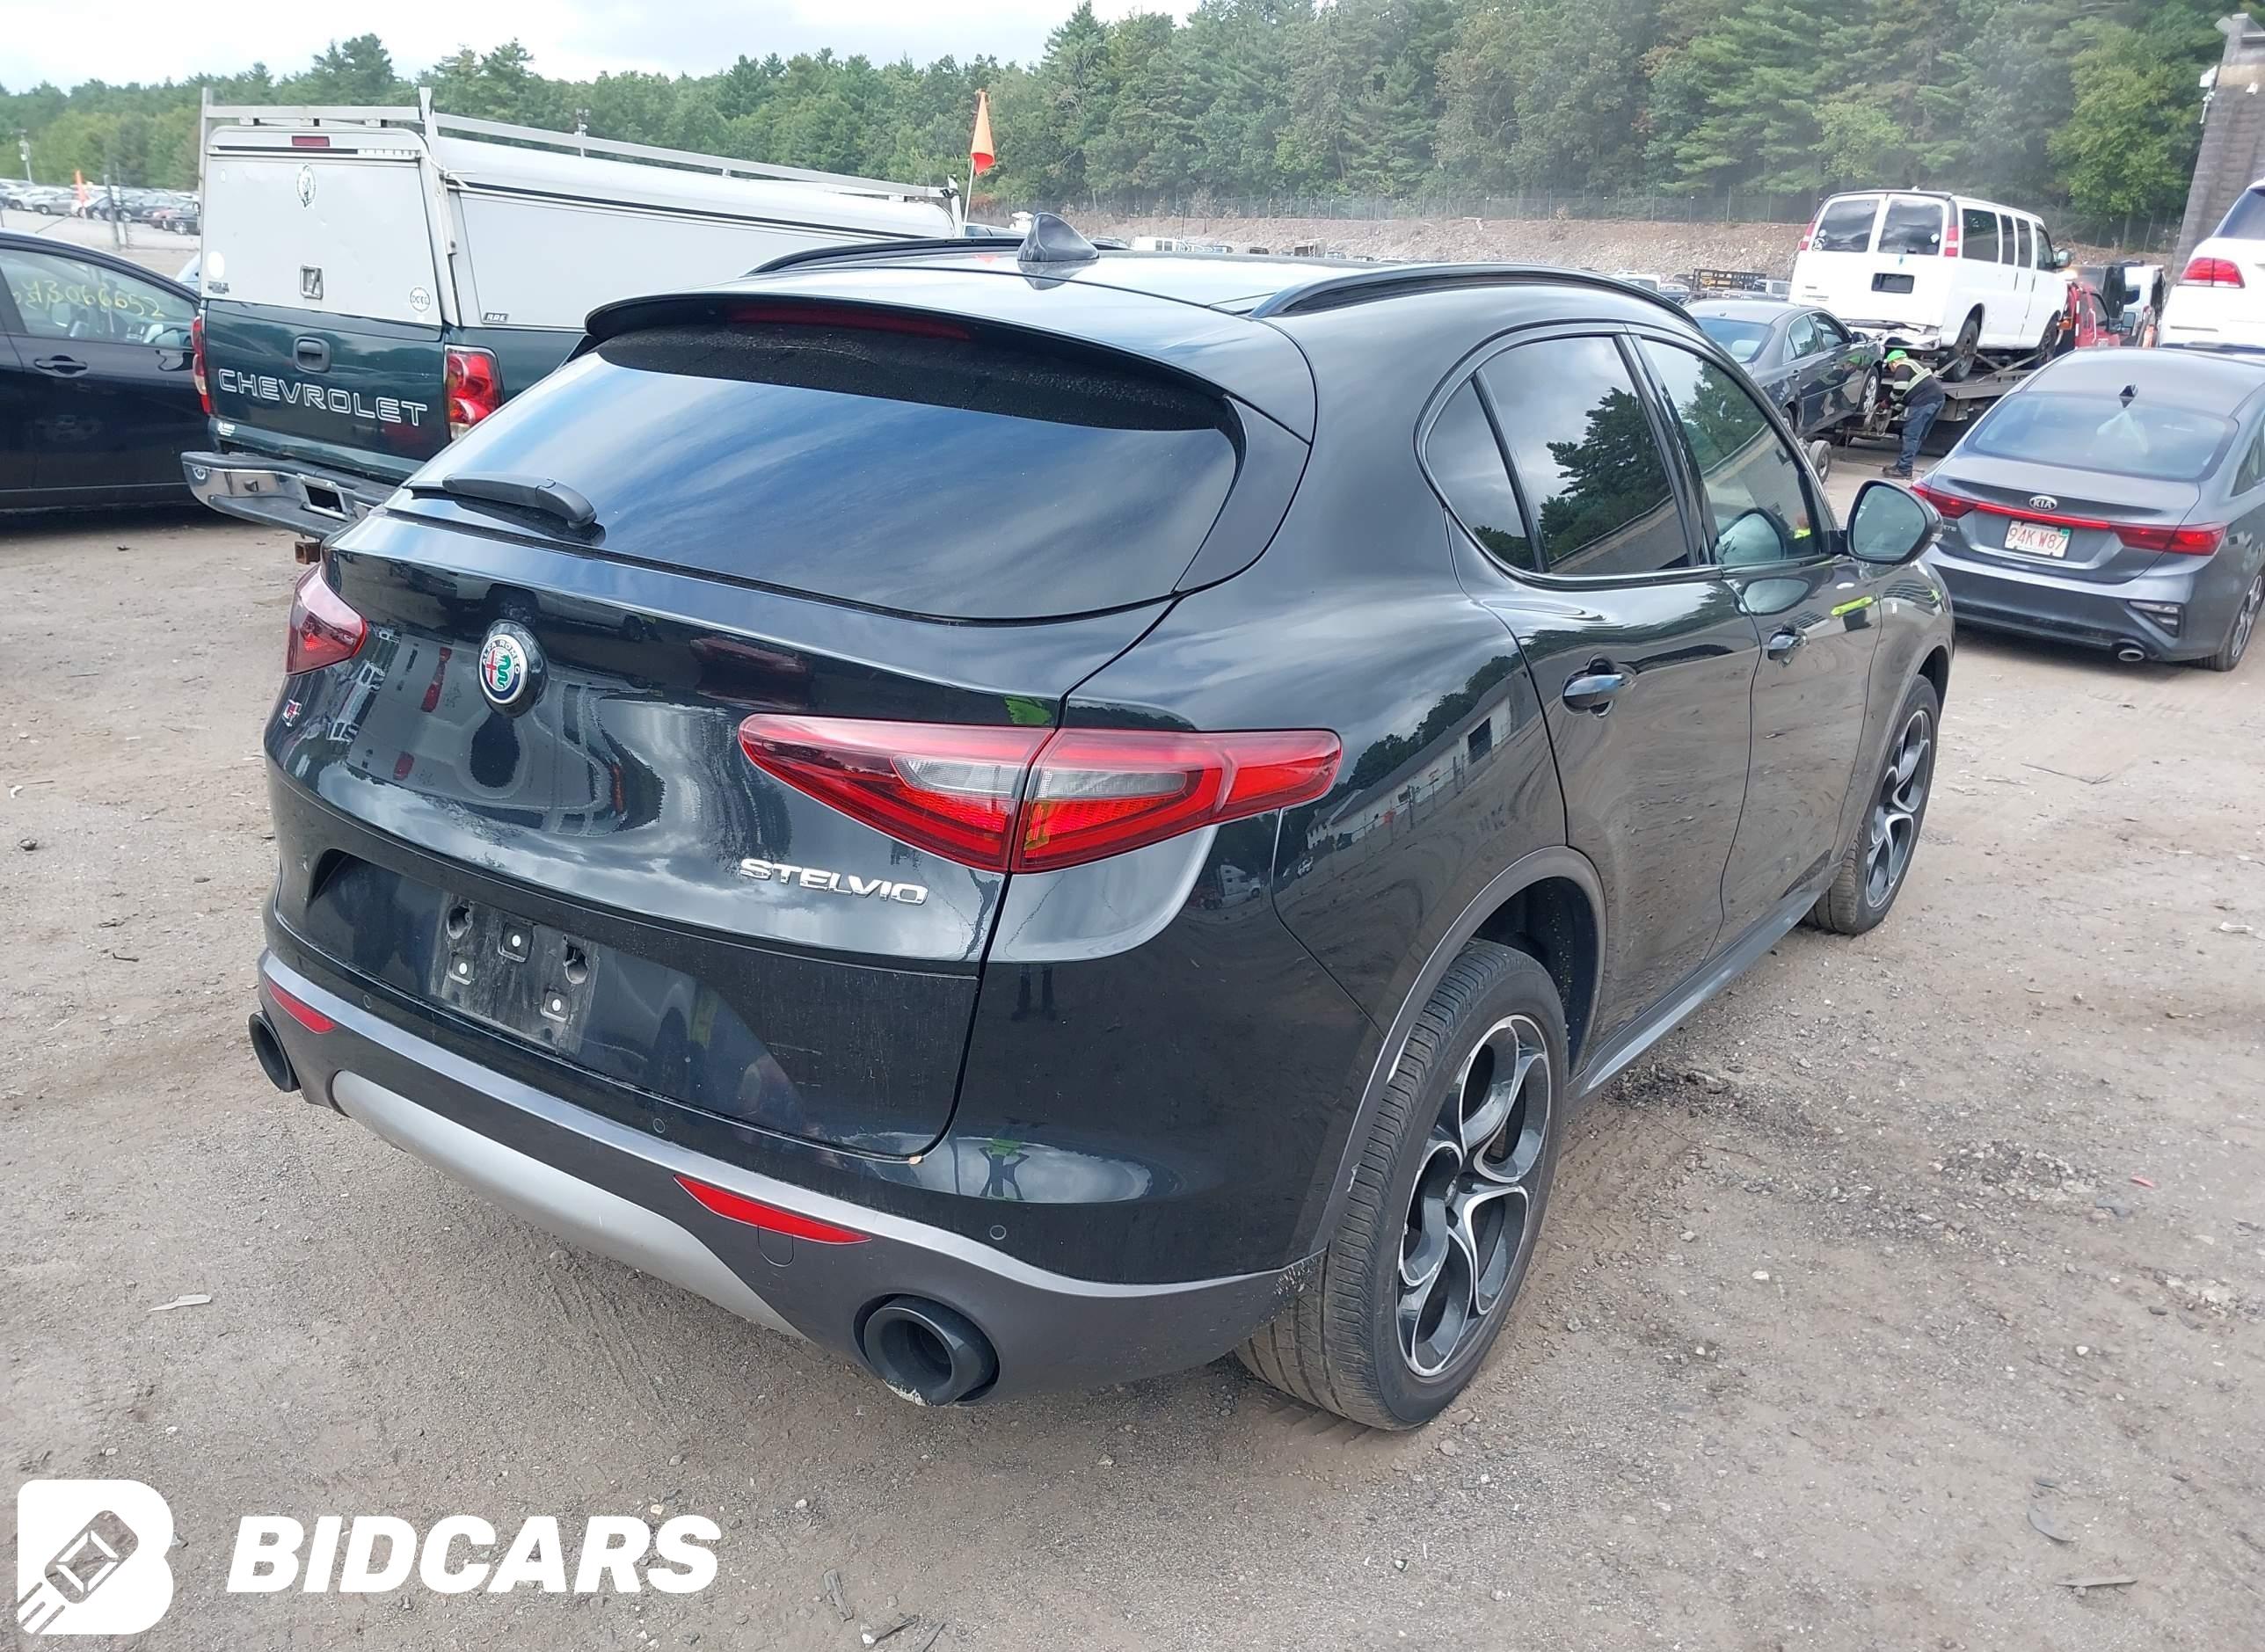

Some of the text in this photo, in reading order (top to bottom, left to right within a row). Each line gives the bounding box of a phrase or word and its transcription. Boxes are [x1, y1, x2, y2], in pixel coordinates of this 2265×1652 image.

[218, 368, 428, 426] CHEVROLET
[2033, 499, 2051, 509] KIA
[2007, 528, 2067, 550] 94K W87
[483, 640, 521, 674] ALFA ROMEO
[739, 858, 929, 906] STELVIO
